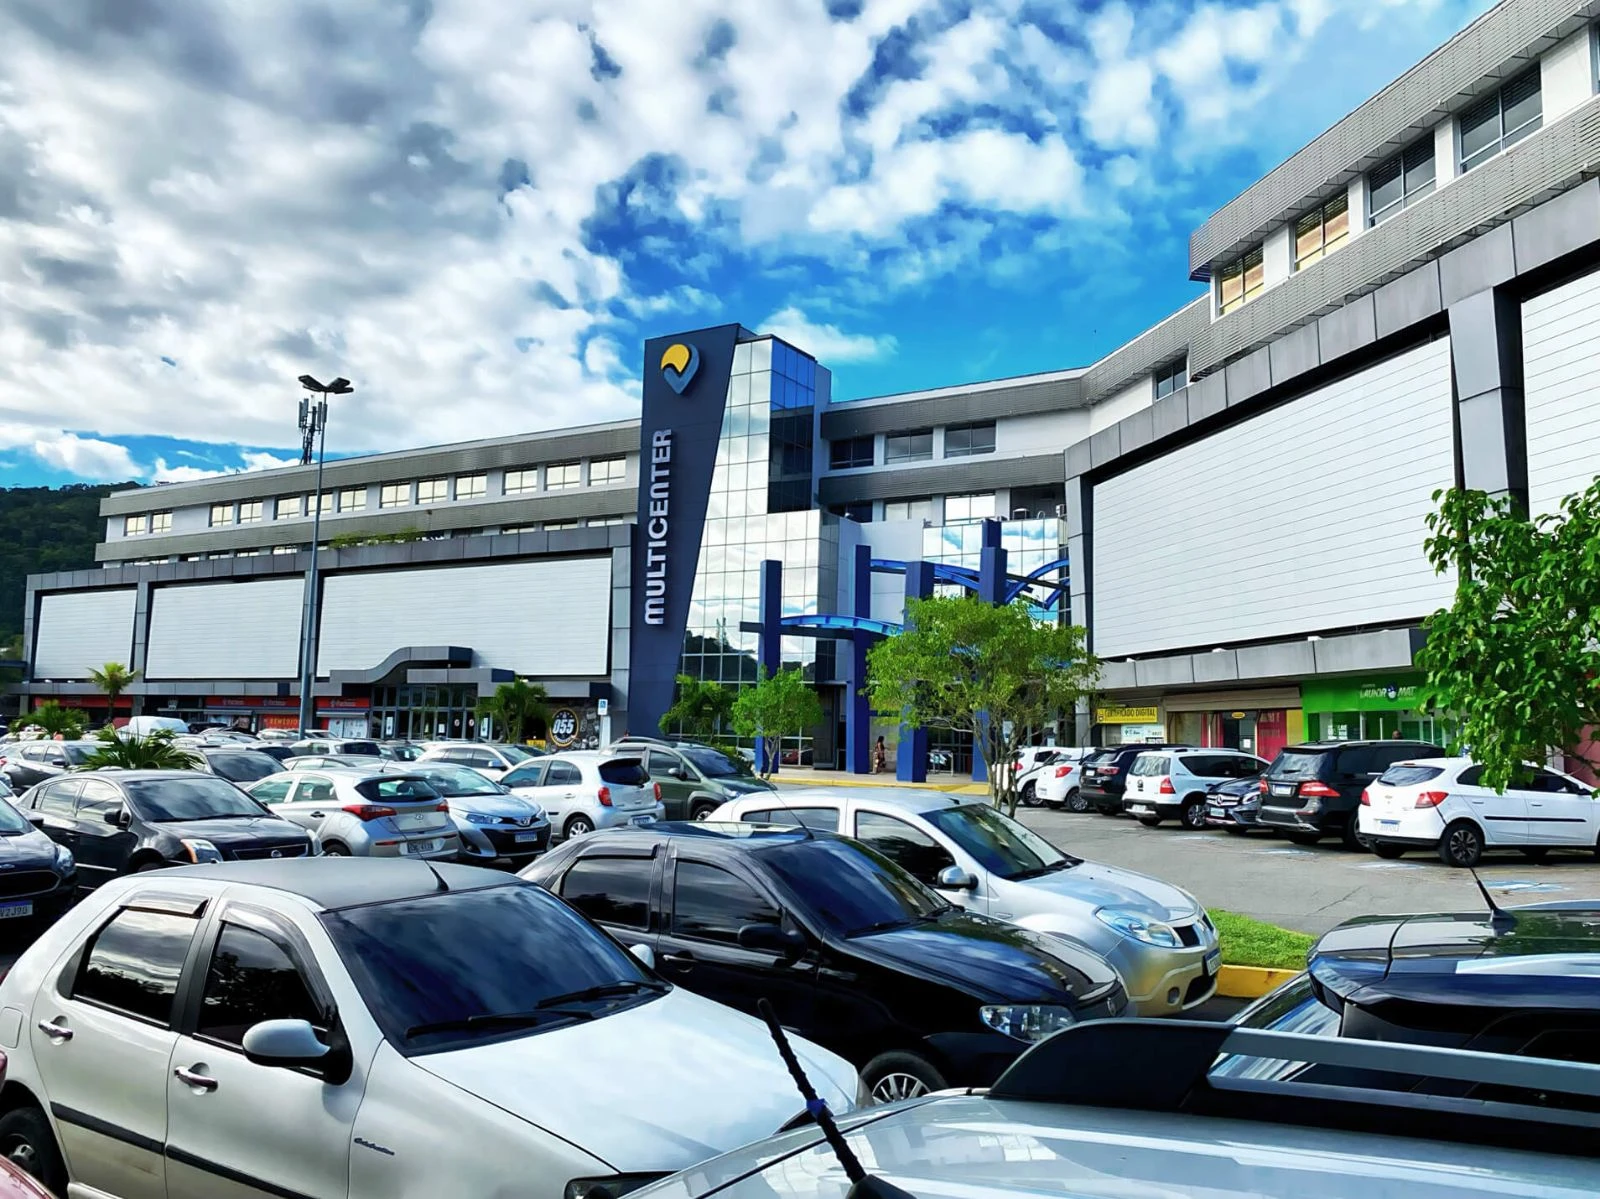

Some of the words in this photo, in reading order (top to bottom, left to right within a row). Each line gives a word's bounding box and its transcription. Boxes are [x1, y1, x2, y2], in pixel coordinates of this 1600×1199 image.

[644, 428, 672, 625] MULTICENTER
[1135, 707, 1155, 717] DIGITAL
[552, 719, 575, 734] 055
